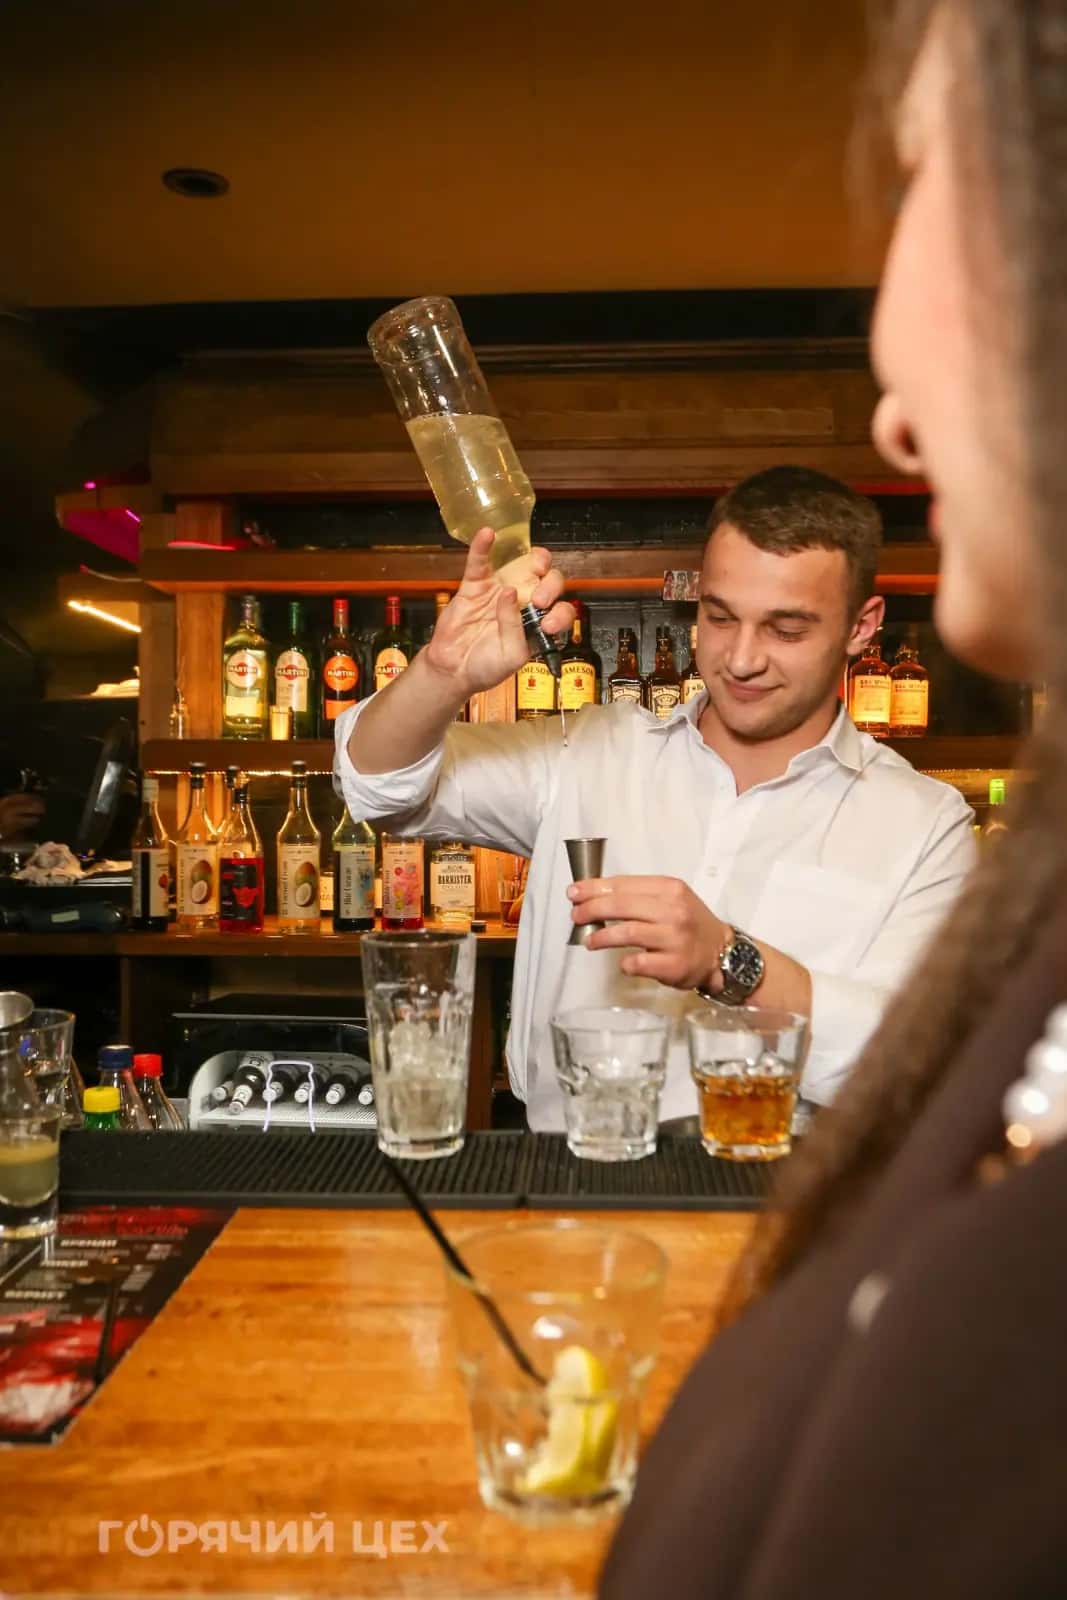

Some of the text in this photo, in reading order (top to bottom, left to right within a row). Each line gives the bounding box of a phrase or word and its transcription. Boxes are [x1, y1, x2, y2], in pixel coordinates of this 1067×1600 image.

[228, 665, 258, 673] MARTINI
[277, 668, 308, 677] MARTINI
[327, 669, 356, 678] MARTINI
[376, 666, 404, 675] MARTIN
[520, 665, 551, 675] AMESO
[564, 664, 594, 676] AMESO
[437, 874, 472, 885] BARRISTER
